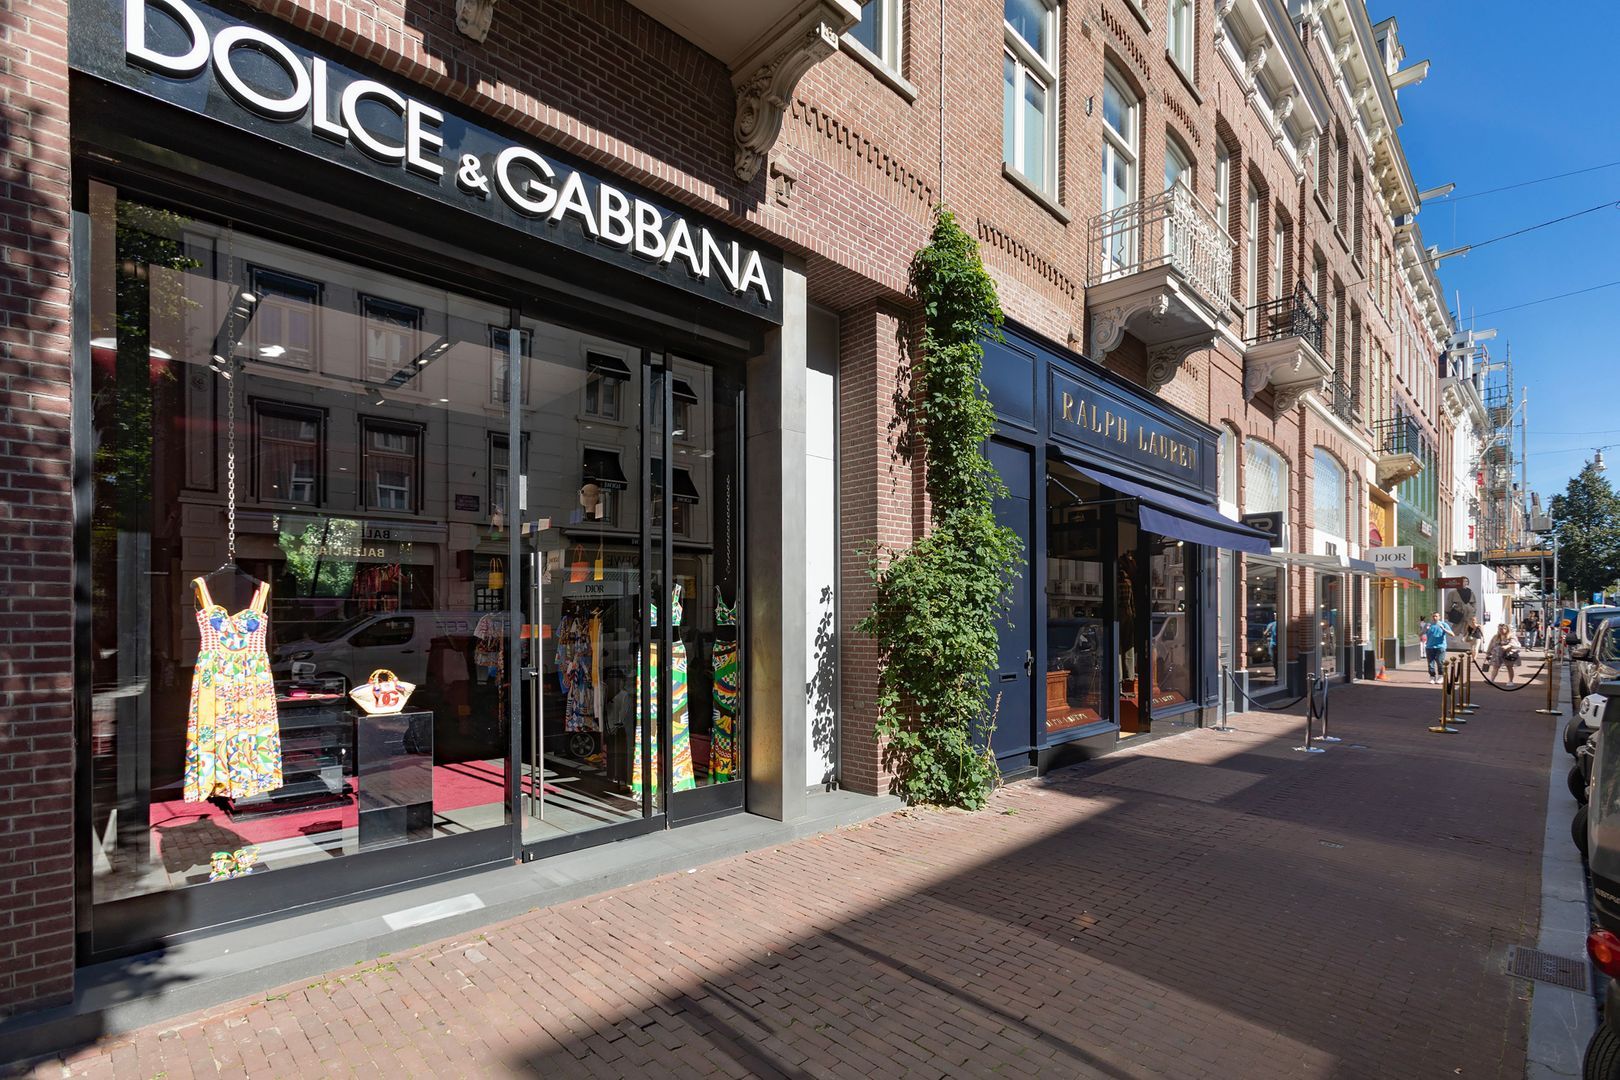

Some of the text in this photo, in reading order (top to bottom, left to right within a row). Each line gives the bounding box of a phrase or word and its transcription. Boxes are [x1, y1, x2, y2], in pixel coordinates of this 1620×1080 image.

[124, 0, 773, 302] DOLCE & GABBANA
[1061, 391, 1197, 470] RALPH LAUREN
[1375, 553, 1407, 562] DIOR
[585, 584, 604, 593] DIOR
